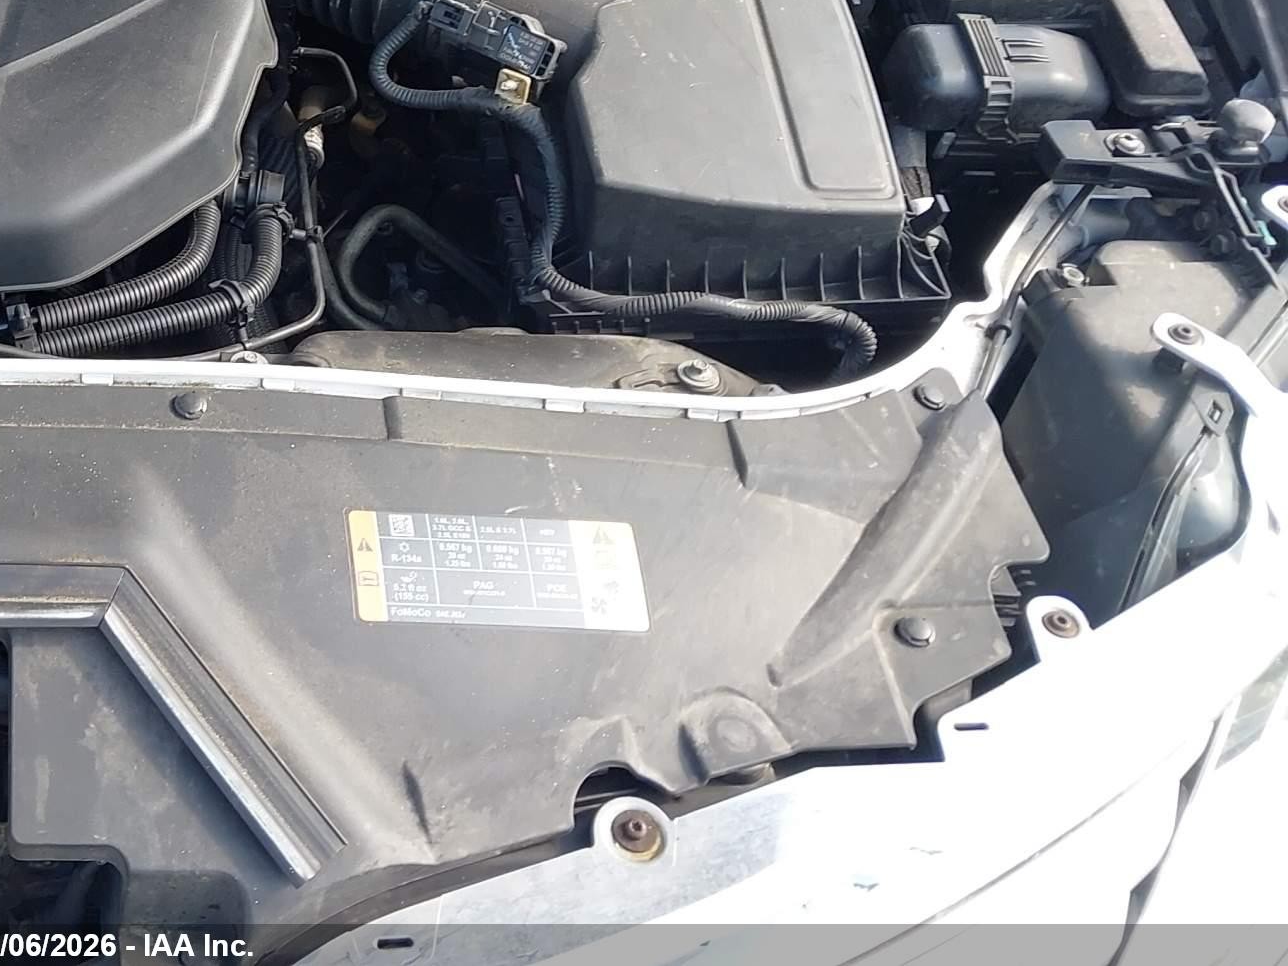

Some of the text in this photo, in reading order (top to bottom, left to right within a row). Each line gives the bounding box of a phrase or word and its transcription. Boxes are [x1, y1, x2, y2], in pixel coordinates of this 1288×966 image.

[391, 554, 423, 563] R-134a
[393, 583, 407, 591] 5.2
[473, 580, 495, 589] PAG
[415, 592, 429, 602] cc)
[390, 607, 432, 618] FoMoCo
